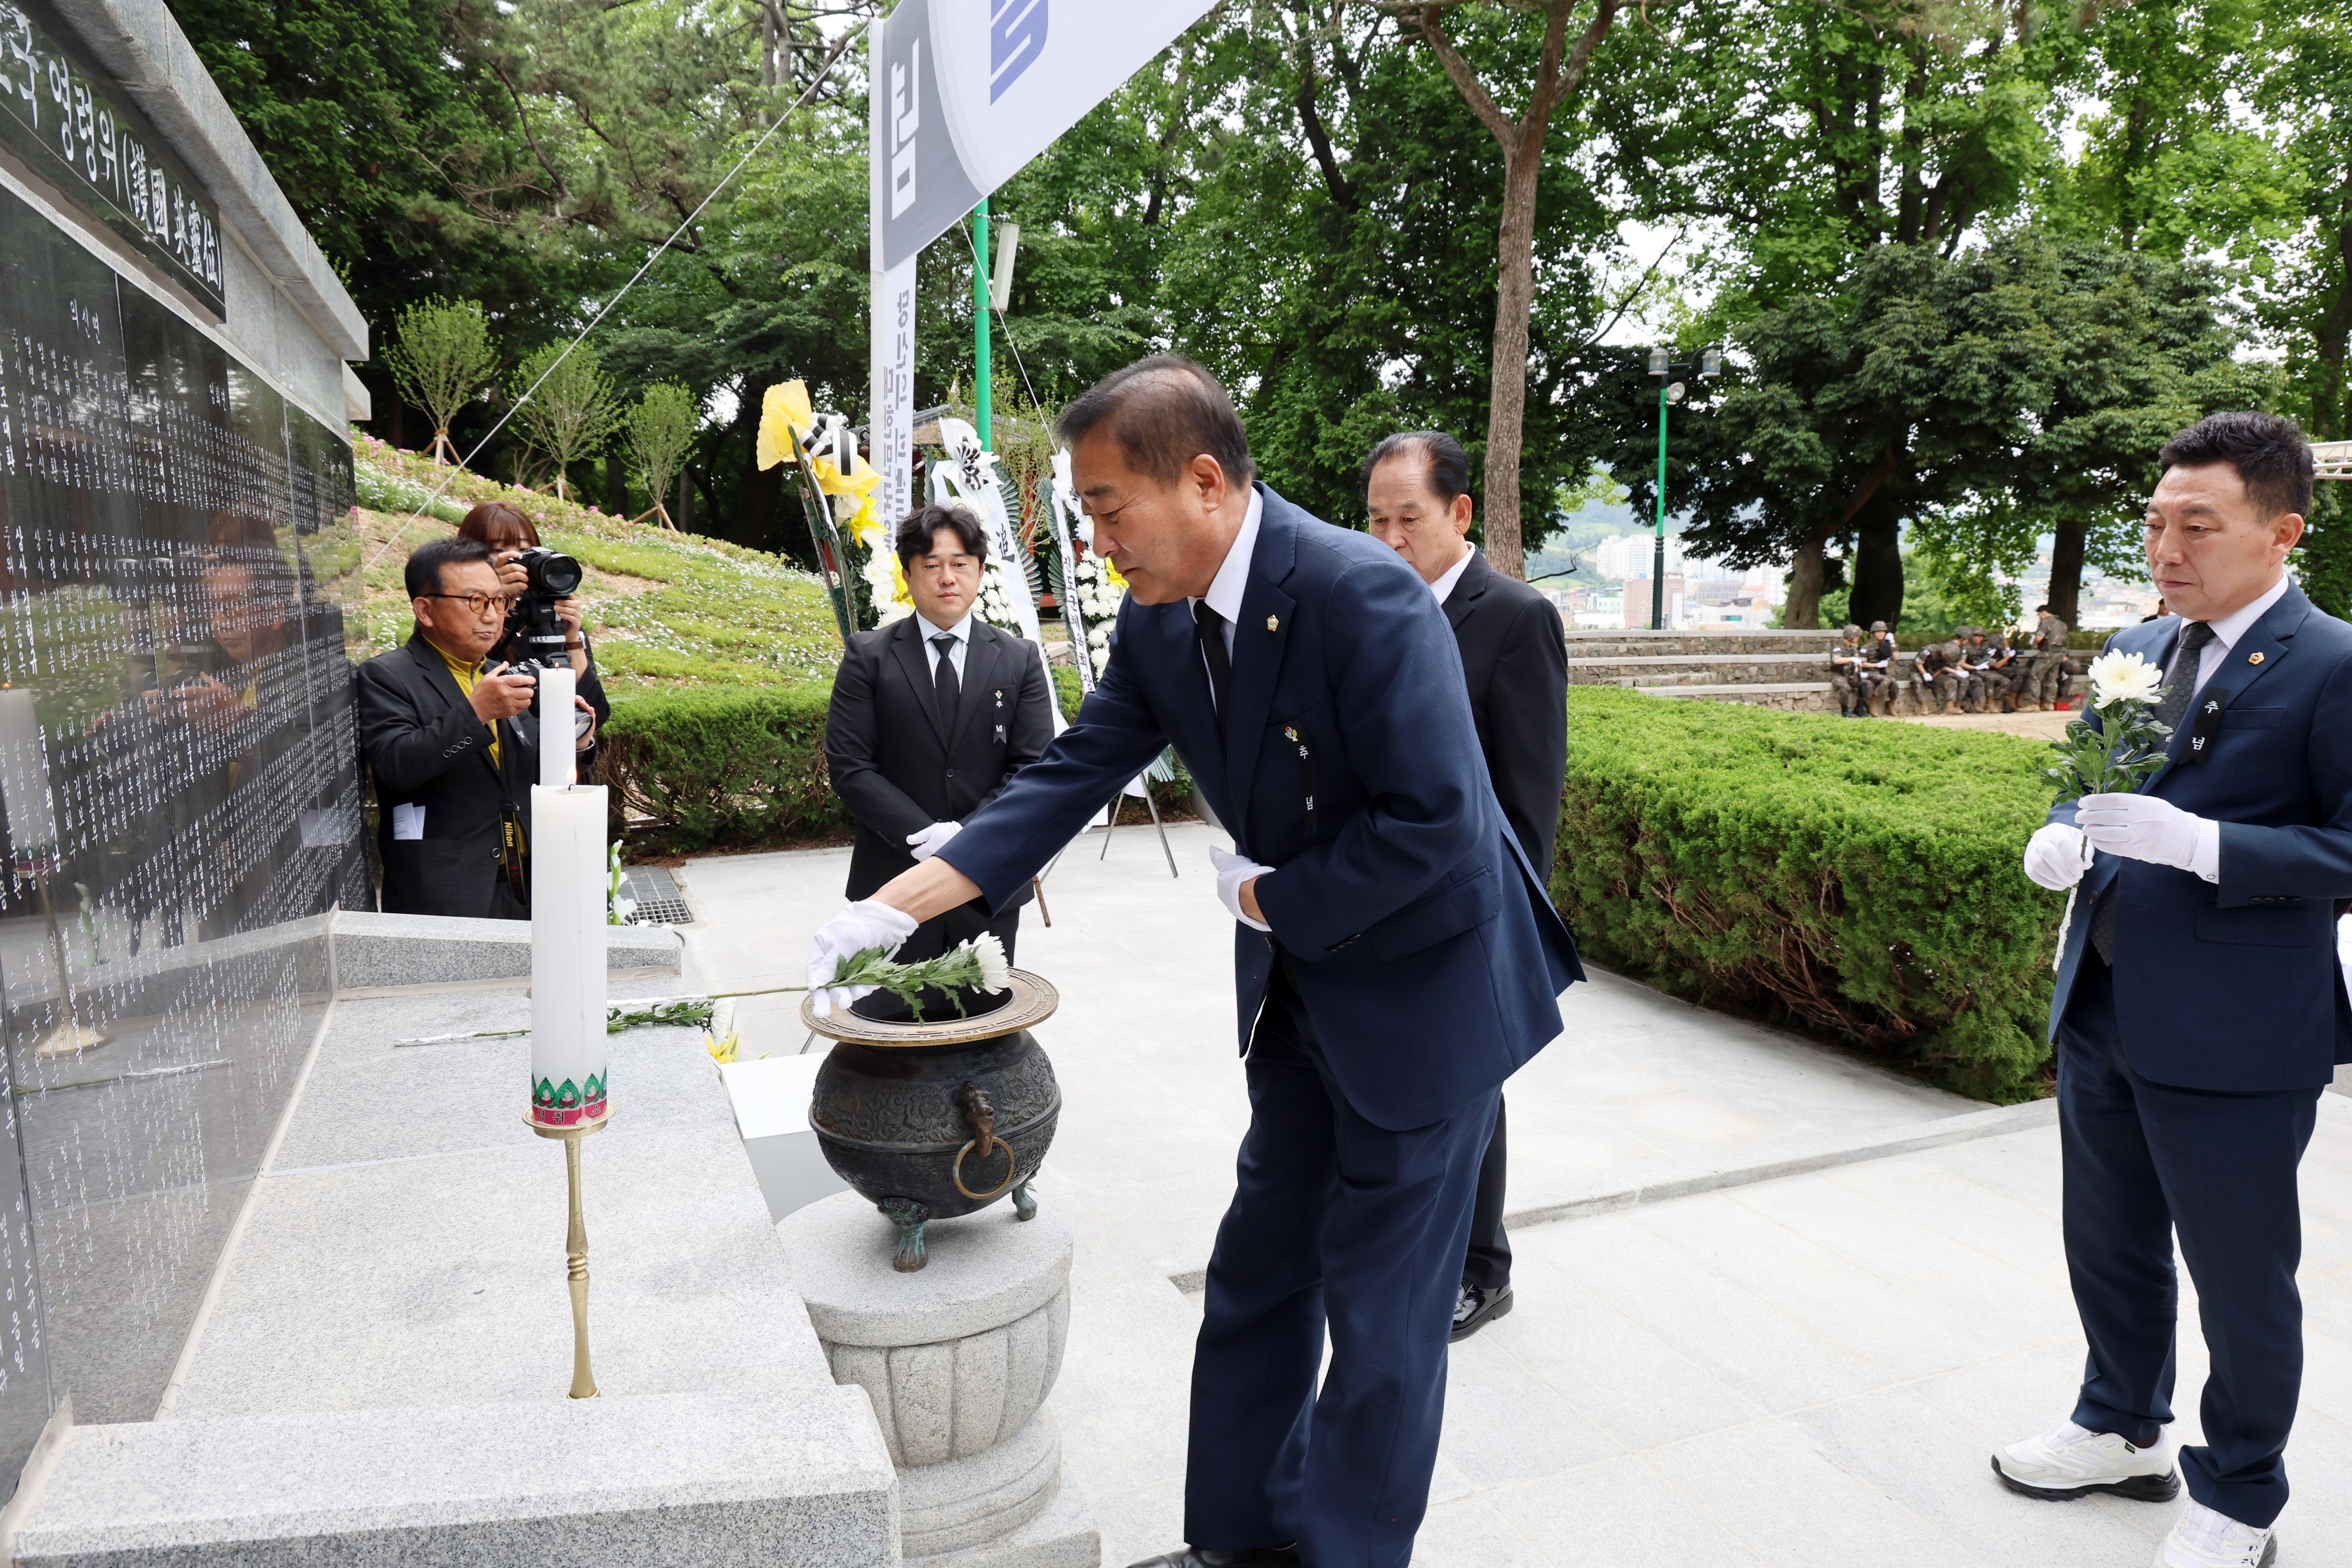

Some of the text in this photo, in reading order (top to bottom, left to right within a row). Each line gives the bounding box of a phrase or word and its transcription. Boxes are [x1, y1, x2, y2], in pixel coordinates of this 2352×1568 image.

[70, 299, 101, 344] 의신면
[24, 335, 35, 386] 일병
[37, 341, 48, 391] 일병
[61, 354, 71, 398] 소위
[11, 328, 33, 477] 중사 강정수
[4, 525, 15, 577] 중위
[34, 528, 45, 577] 상사
[47, 529, 57, 580] 중령
[58, 530, 70, 576] 하사
[70, 531, 80, 576] 중사
[81, 532, 91, 578] 일병
[92, 533, 102, 576] 하사
[102, 534, 110, 576] 중사
[111, 535, 120, 575] 중사
[120, 536, 128, 578] 상병
[995, 523, 1015, 563] 追
[15, 525, 38, 676] 상사 김형규
[80, 715, 89, 762] 상병
[90, 711, 100, 757] 상병
[100, 708, 110, 753] 일병
[110, 705, 119, 749] 일병
[128, 700, 136, 741] 병장
[136, 697, 145, 738] 병장
[2191, 700, 2219, 750] 추 념
[56, 723, 67, 769] 하사
[68, 719, 79, 765] 하사
[1299, 745, 1309, 760] 추
[38, 724, 61, 874] 중사 최기남
[62, 926, 73, 975] 병장
[15, 1191, 28, 1248] 이병
